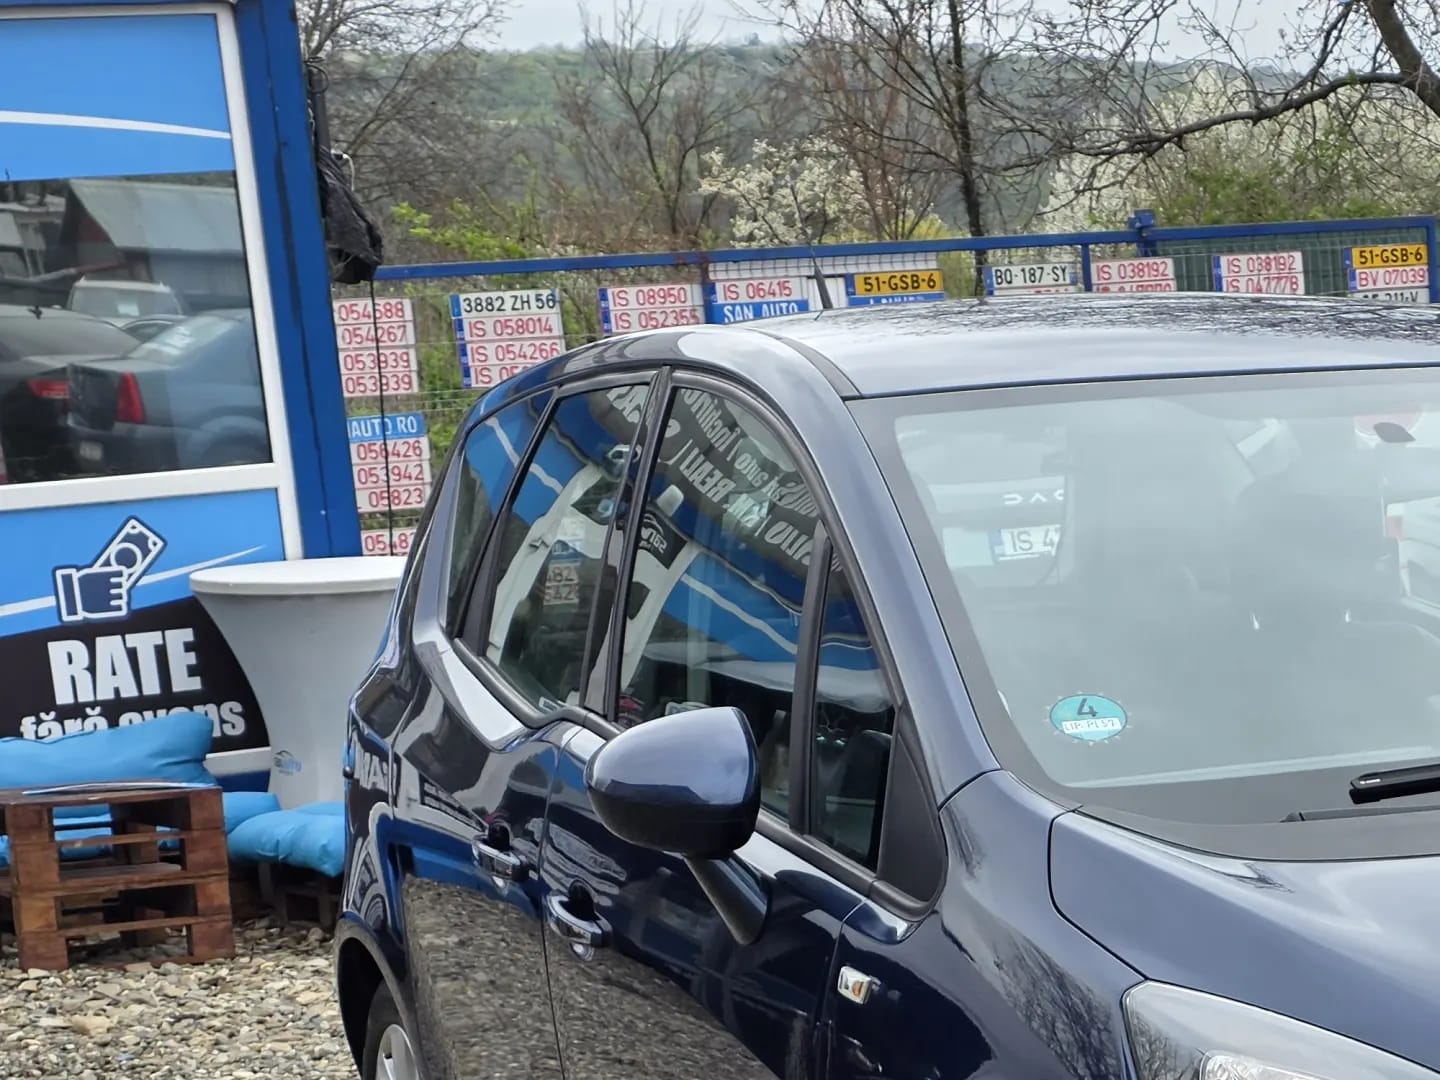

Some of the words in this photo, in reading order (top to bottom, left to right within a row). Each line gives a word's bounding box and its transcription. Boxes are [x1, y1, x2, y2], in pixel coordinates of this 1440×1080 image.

[1226, 257, 1241, 274] IS
[1246, 254, 1297, 273] 038192
[1359, 247, 1423, 265] 51-GSB-6
[1096, 264, 1112, 281] IS
[1118, 260, 1168, 279] 038192
[1358, 271, 1379, 287] BV
[1384, 267, 1428, 285] 07039
[722, 283, 740, 301] IS
[745, 280, 793, 299] 06415
[863, 272, 937, 292] 51-GSB-6
[463, 296, 506, 314] 3882
[511, 294, 531, 311] ZH
[535, 293, 557, 310] 56
[611, 289, 630, 307] IS
[635, 286, 687, 306] 08950
[614, 312, 632, 330] IS
[723, 304, 754, 323] SAN
[341, 324, 407, 345] 054267
[468, 320, 487, 338] IS
[493, 316, 553, 337] 058014
[470, 345, 490, 363] IS
[494, 342, 560, 362] 054266
[474, 366, 494, 385] IS
[396, 416, 417, 434] RO
[1010, 530, 1033, 552] IS
[47, 627, 202, 705] RATE
[1076, 698, 1098, 717] 4
